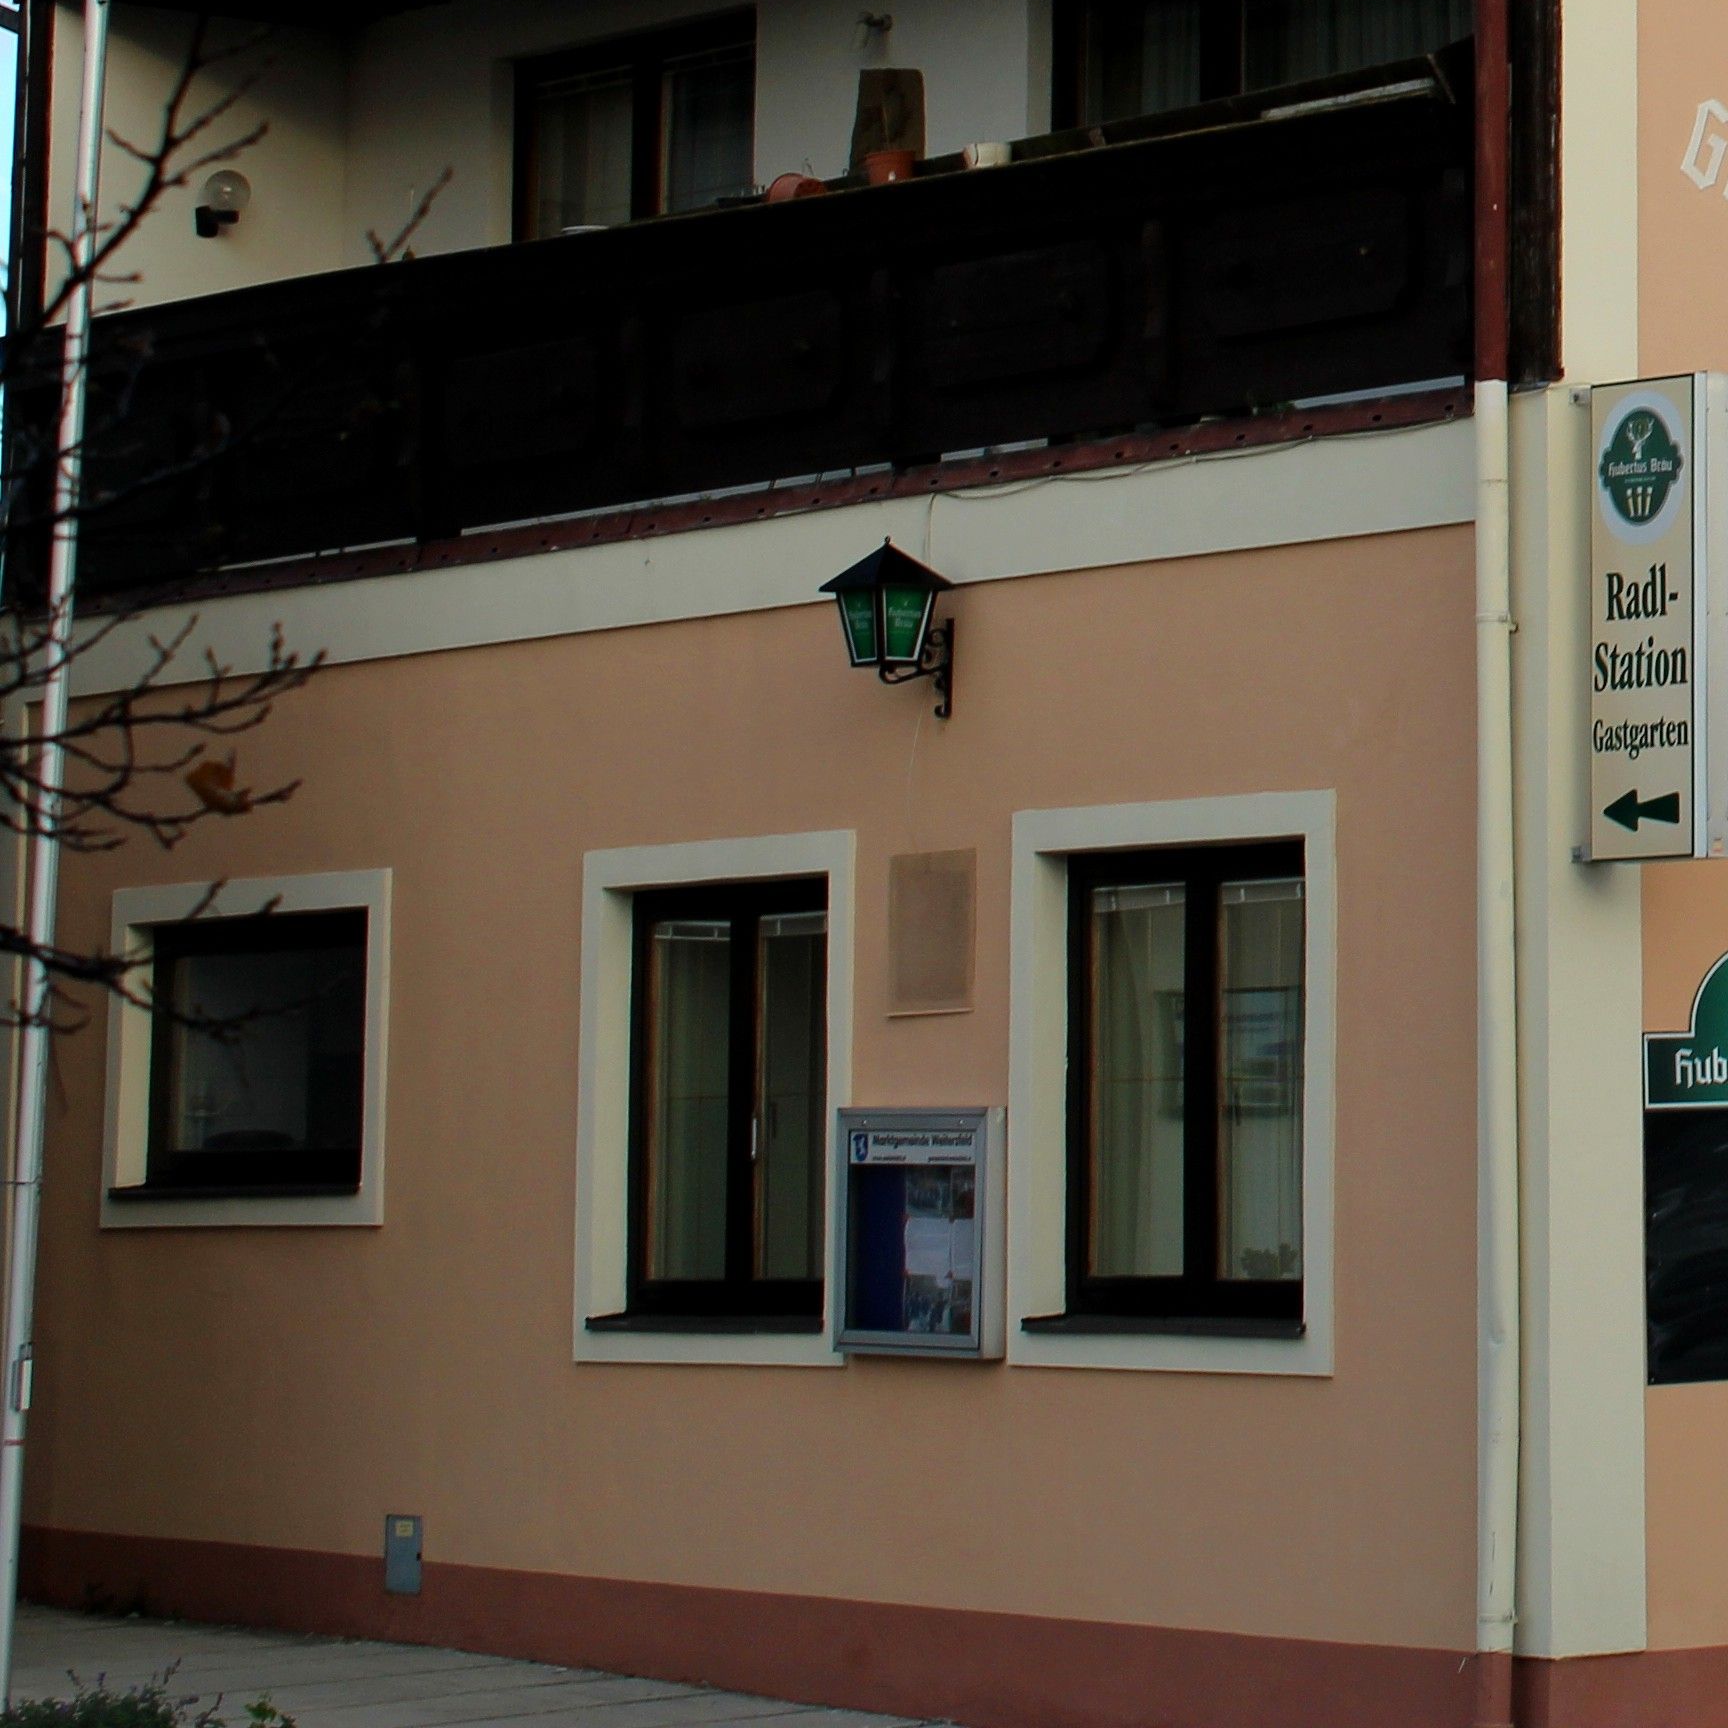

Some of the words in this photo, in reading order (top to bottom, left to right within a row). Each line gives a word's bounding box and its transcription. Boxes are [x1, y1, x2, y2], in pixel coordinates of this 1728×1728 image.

[1605, 562, 1679, 622] Radl-
[1593, 635, 1689, 693] Station
[1592, 715, 1689, 761] Gastgarten
